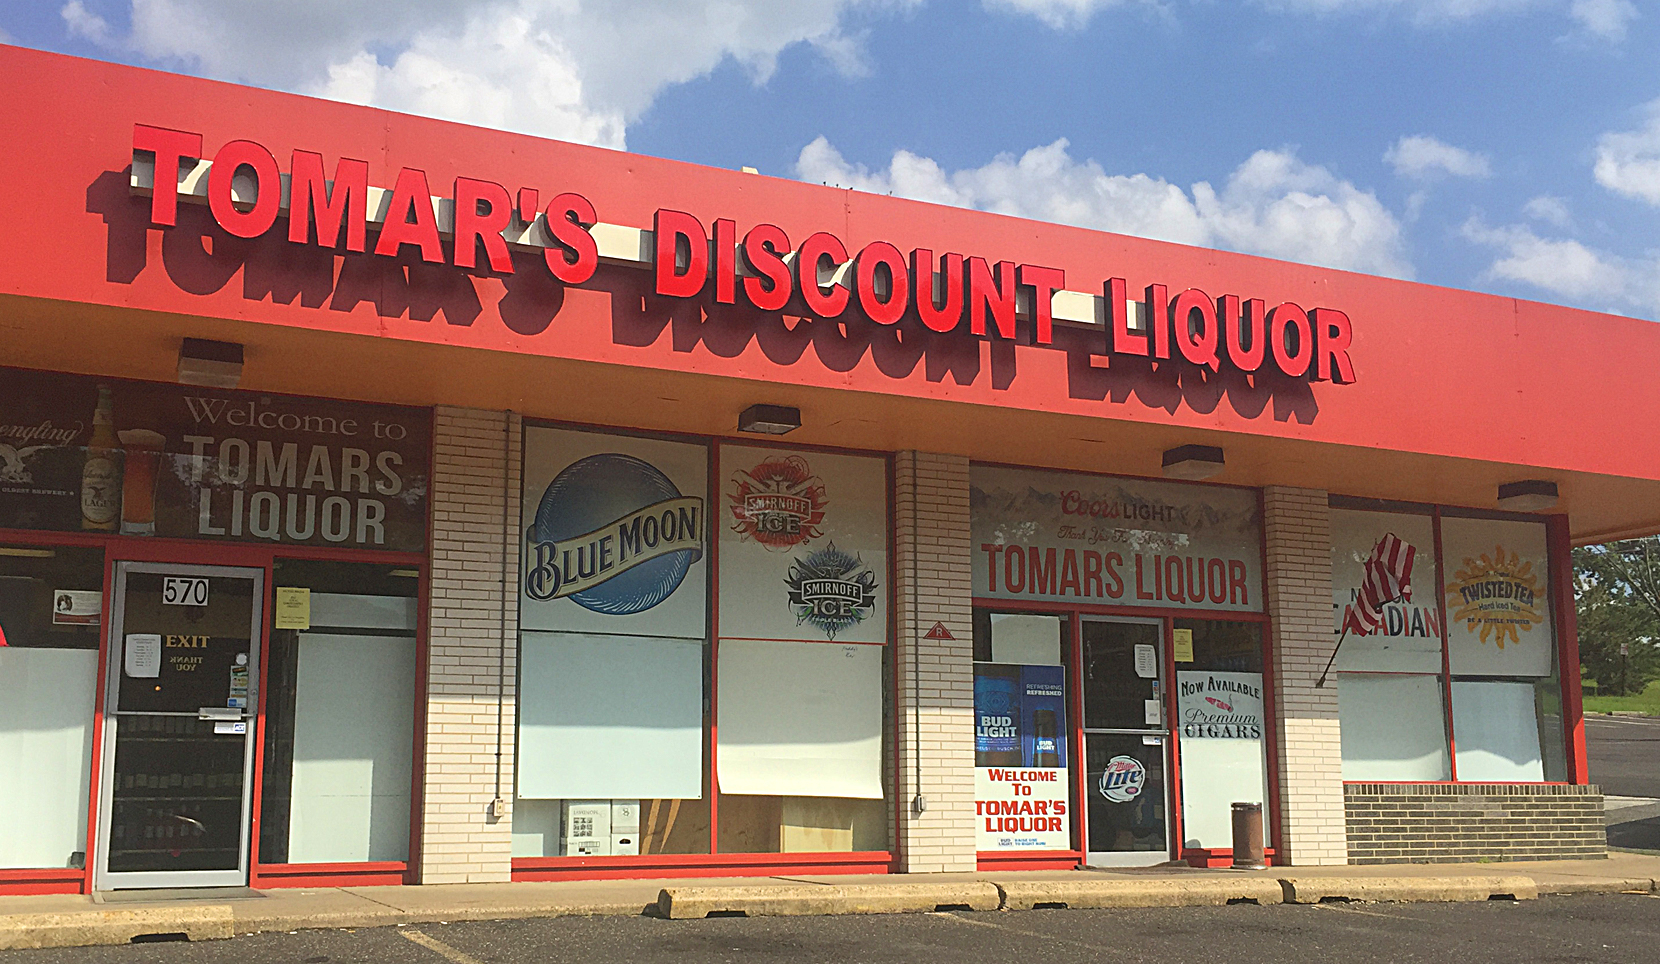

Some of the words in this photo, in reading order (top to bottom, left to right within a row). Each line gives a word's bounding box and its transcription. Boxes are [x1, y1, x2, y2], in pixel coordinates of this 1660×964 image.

[133, 123, 598, 286] TOMAR'S
[654, 208, 1066, 346] DISCOUNT
[1103, 277, 1356, 385] LIQUOR
[183, 396, 359, 436] Welcome
[372, 418, 407, 440] to
[183, 434, 404, 496] TOMARS
[749, 496, 807, 513] SMIRNOFF
[1060, 490, 1120, 519] Coors
[1123, 503, 1174, 522] LIGHT
[199, 486, 386, 545] LIQUOR
[757, 514, 802, 533] ICE
[527, 534, 614, 600] BLUE
[619, 505, 698, 563] MOON
[981, 544, 1124, 599] TOMARS
[1135, 553, 1249, 605] LIQUOR
[164, 579, 207, 604] 570
[806, 582, 858, 597] SMIRNOFF
[1460, 581, 1513, 605] TWISTED
[1514, 582, 1534, 608] TEA
[812, 600, 852, 616] ICE
[1478, 601, 1495, 611] Hard
[1510, 602, 1521, 612] Tea
[1332, 604, 1440, 638] AADIAN
[935, 627, 943, 637] R
[165, 635, 210, 648] EXIT
[981, 716, 1012, 727] BUD
[1185, 707, 1258, 724] Premium
[976, 726, 1017, 738] LIGHT
[1184, 724, 1261, 739] CIGARS
[988, 769, 1057, 781] WELCOME
[1107, 761, 1136, 772] Miller
[1104, 770, 1144, 790] Lite
[974, 800, 1066, 815] TOMAR'S
[985, 817, 1063, 834] LIQUOR
